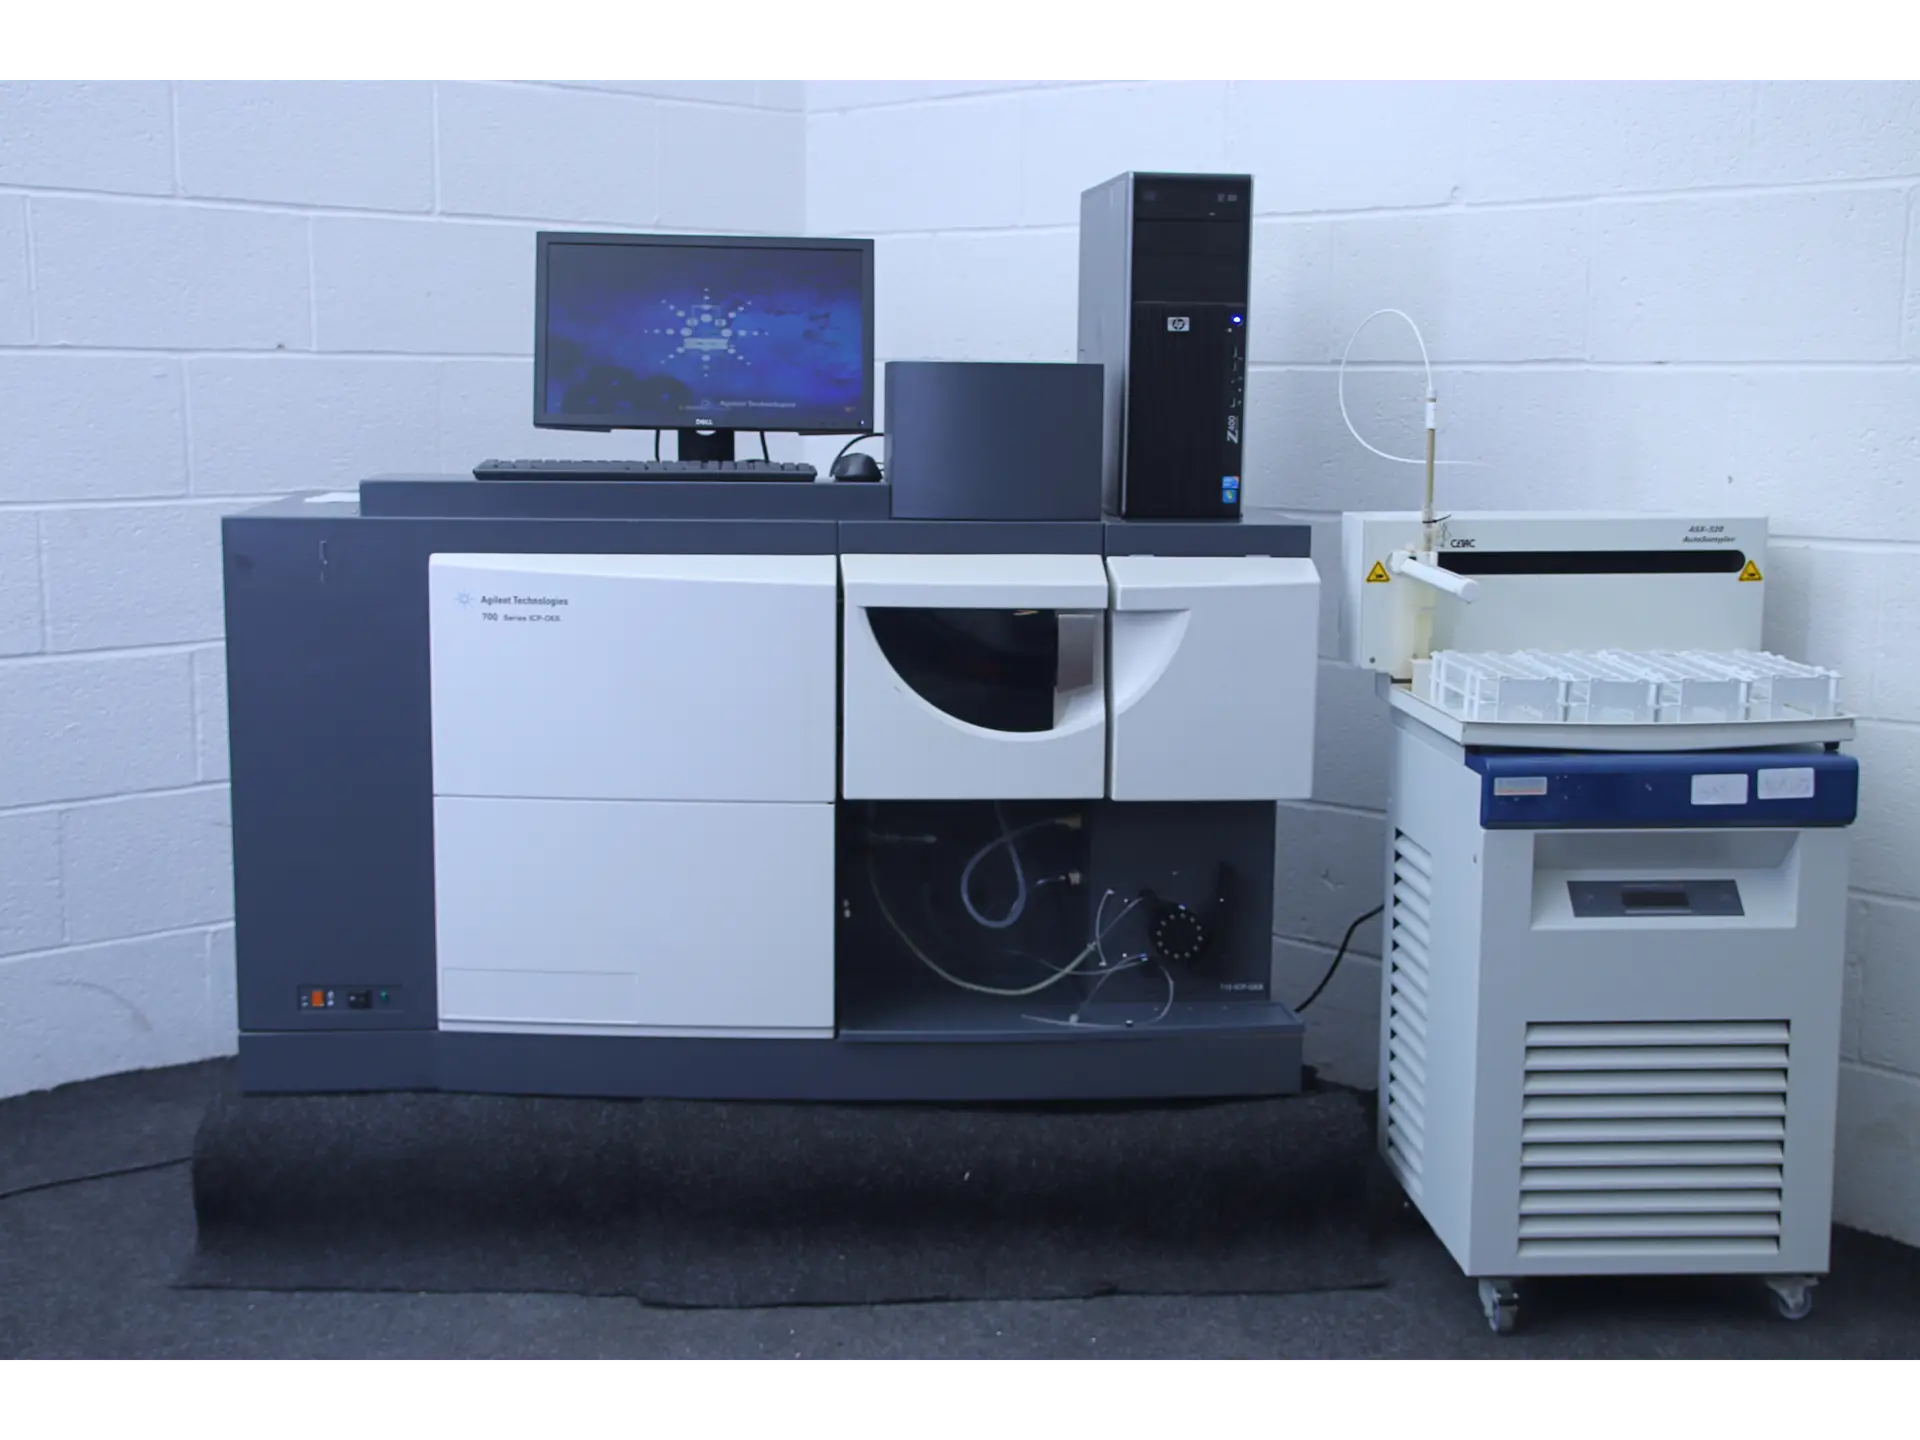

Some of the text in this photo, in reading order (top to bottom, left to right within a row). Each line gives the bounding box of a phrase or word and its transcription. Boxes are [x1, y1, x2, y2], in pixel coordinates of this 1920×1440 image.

[695, 418, 713, 426] DELL
[480, 595, 569, 607] Agilent Technologies
[482, 612, 498, 621] 700
[503, 613, 527, 622] Series
